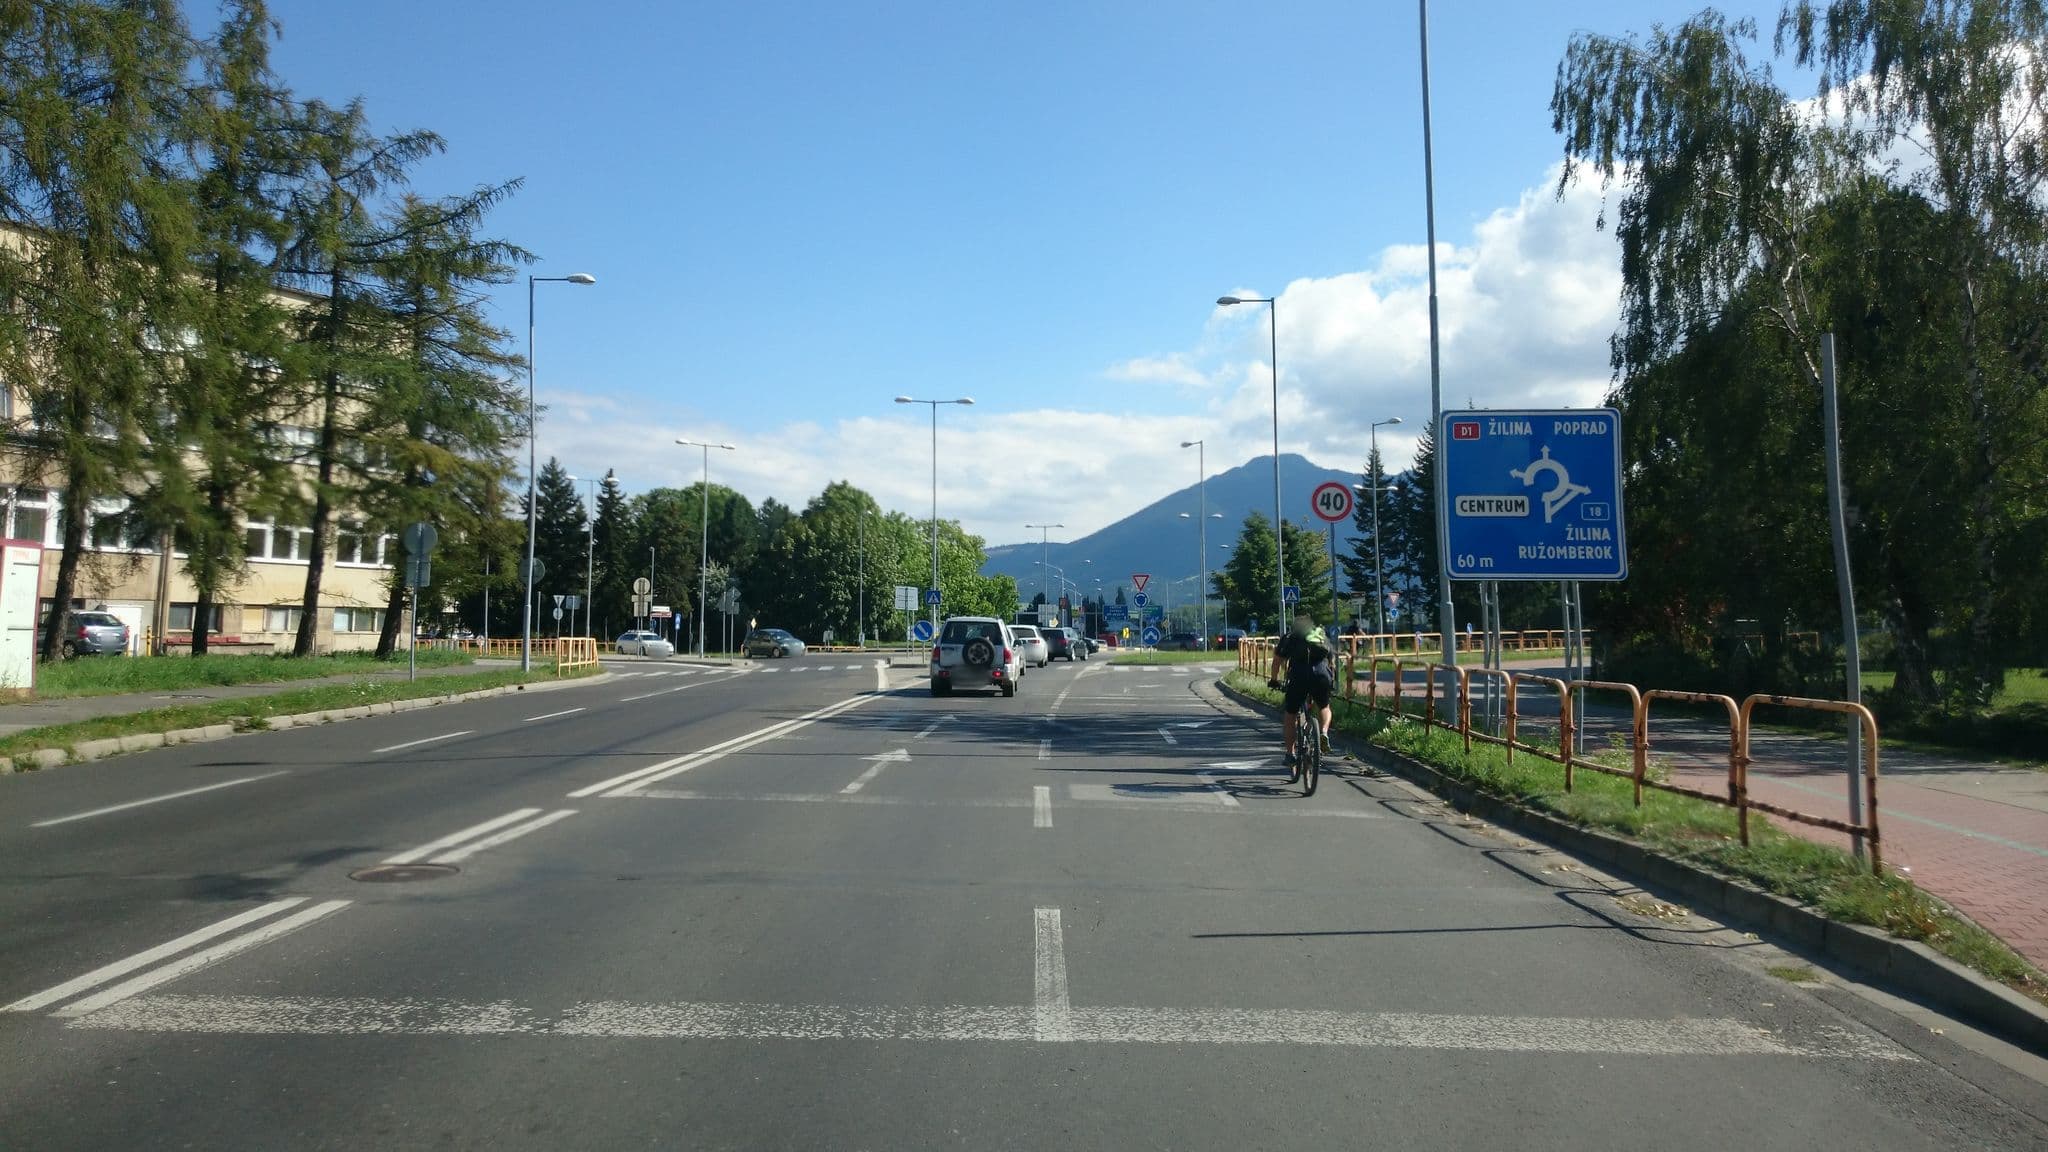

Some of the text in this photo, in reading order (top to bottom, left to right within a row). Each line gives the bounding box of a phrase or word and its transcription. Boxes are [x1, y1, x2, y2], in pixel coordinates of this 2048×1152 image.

[1461, 418, 1607, 436] D1 ŽILINA POPRAD
[1320, 492, 1344, 511] 40
[1460, 499, 1526, 513] CENTRUM
[1589, 506, 1602, 516] 18
[1565, 523, 1611, 541] ŽILINA
[1518, 542, 1613, 560] RUŽOMBEROK
[1457, 554, 1494, 568] 60 m
